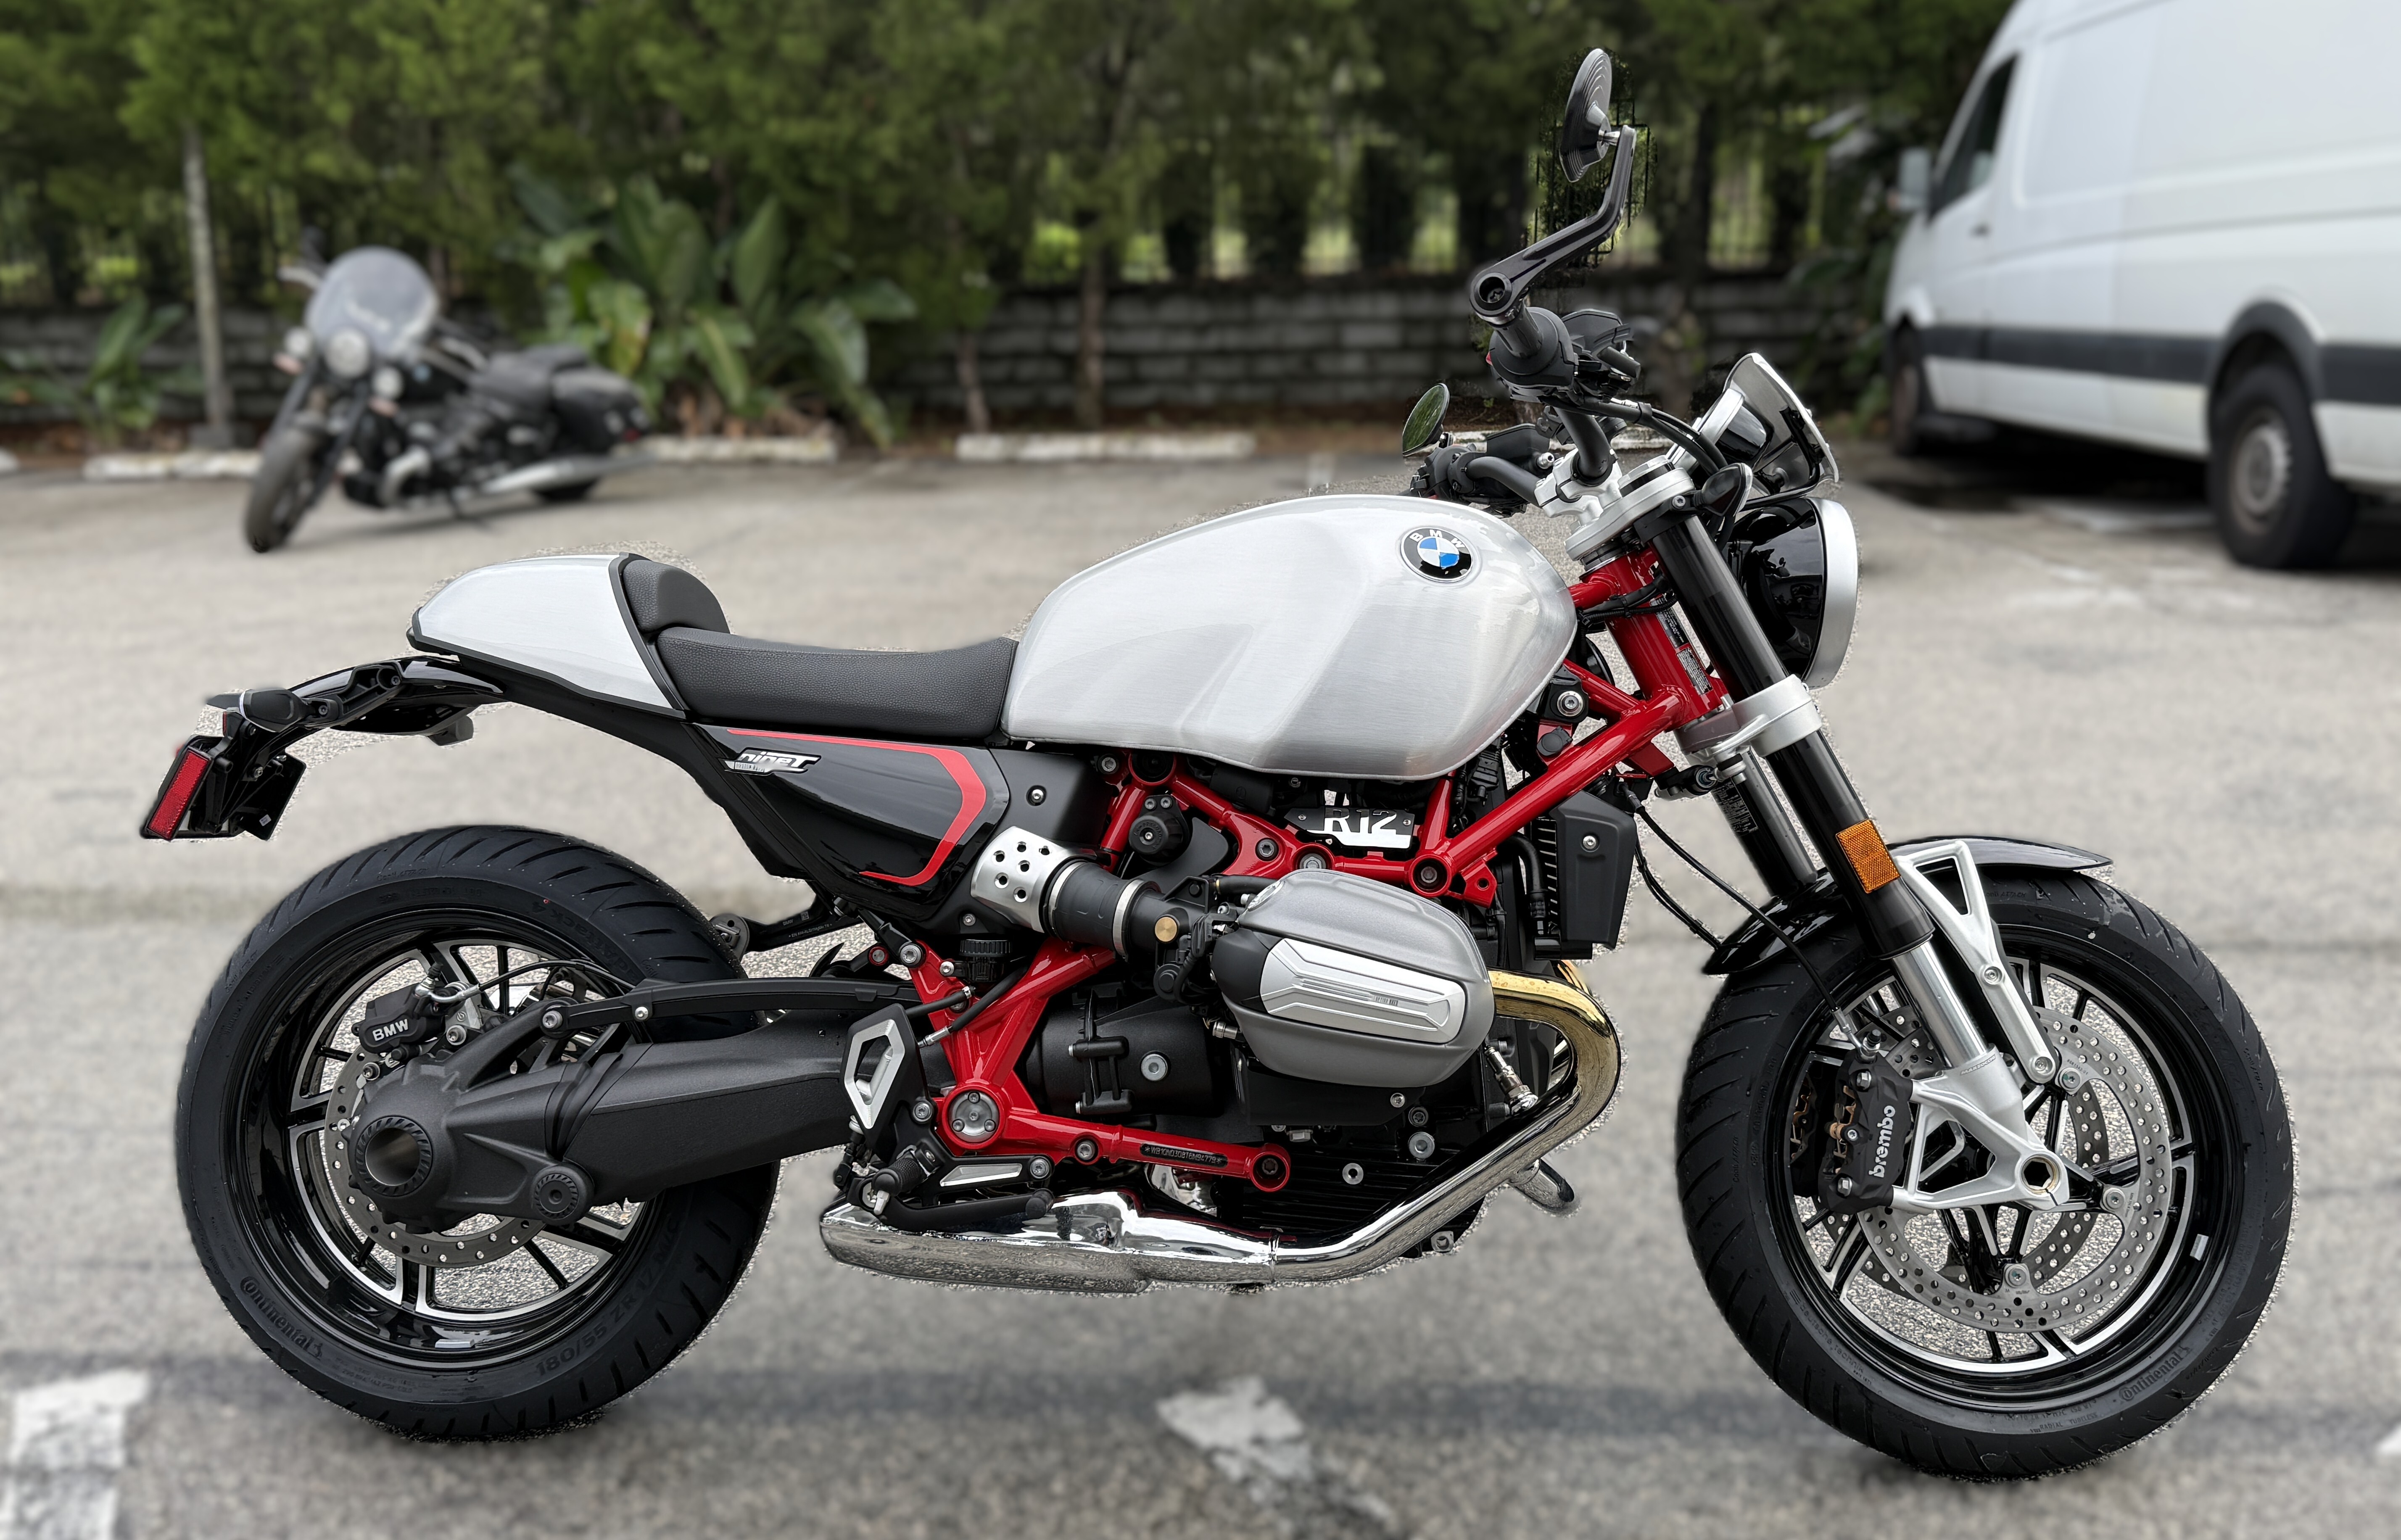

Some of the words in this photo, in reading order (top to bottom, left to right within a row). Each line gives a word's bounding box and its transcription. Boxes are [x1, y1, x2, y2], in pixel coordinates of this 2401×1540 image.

[1409, 529, 1466, 548] BMW
[372, 1019, 408, 1041] BMW
[1868, 1105, 1896, 1178] brembo
[240, 1276, 315, 1350] Continental
[535, 1321, 608, 1376] 180/55
[2119, 1351, 2184, 1401] Continental
